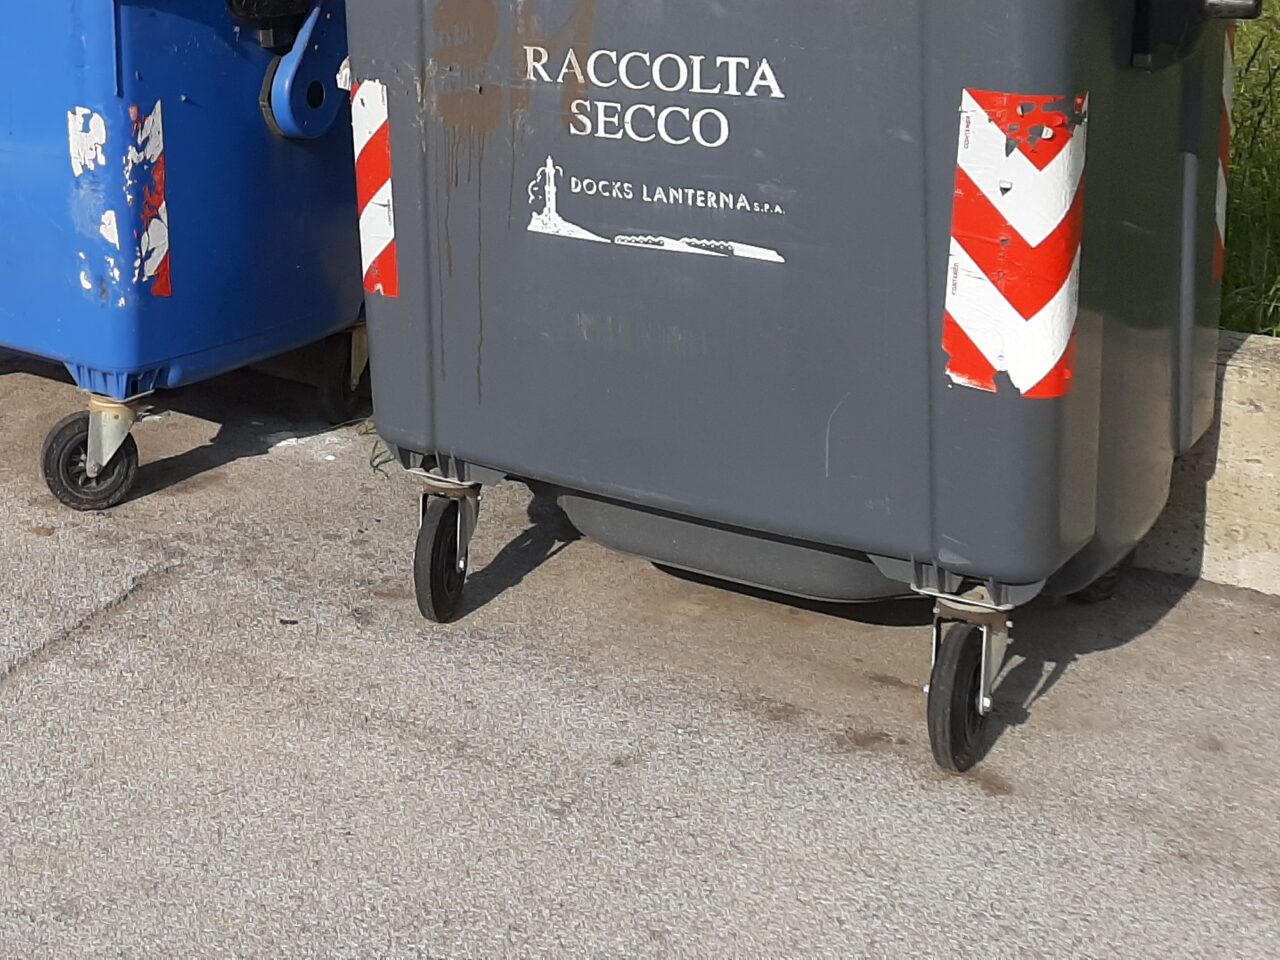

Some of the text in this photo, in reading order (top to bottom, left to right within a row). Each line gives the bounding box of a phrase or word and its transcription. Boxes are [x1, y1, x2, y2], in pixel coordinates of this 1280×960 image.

[522, 45, 785, 99] RACCOLTA
[569, 99, 730, 148] SECCO
[570, 176, 634, 200] DOCKS
[642, 184, 751, 211] LANTERNA
